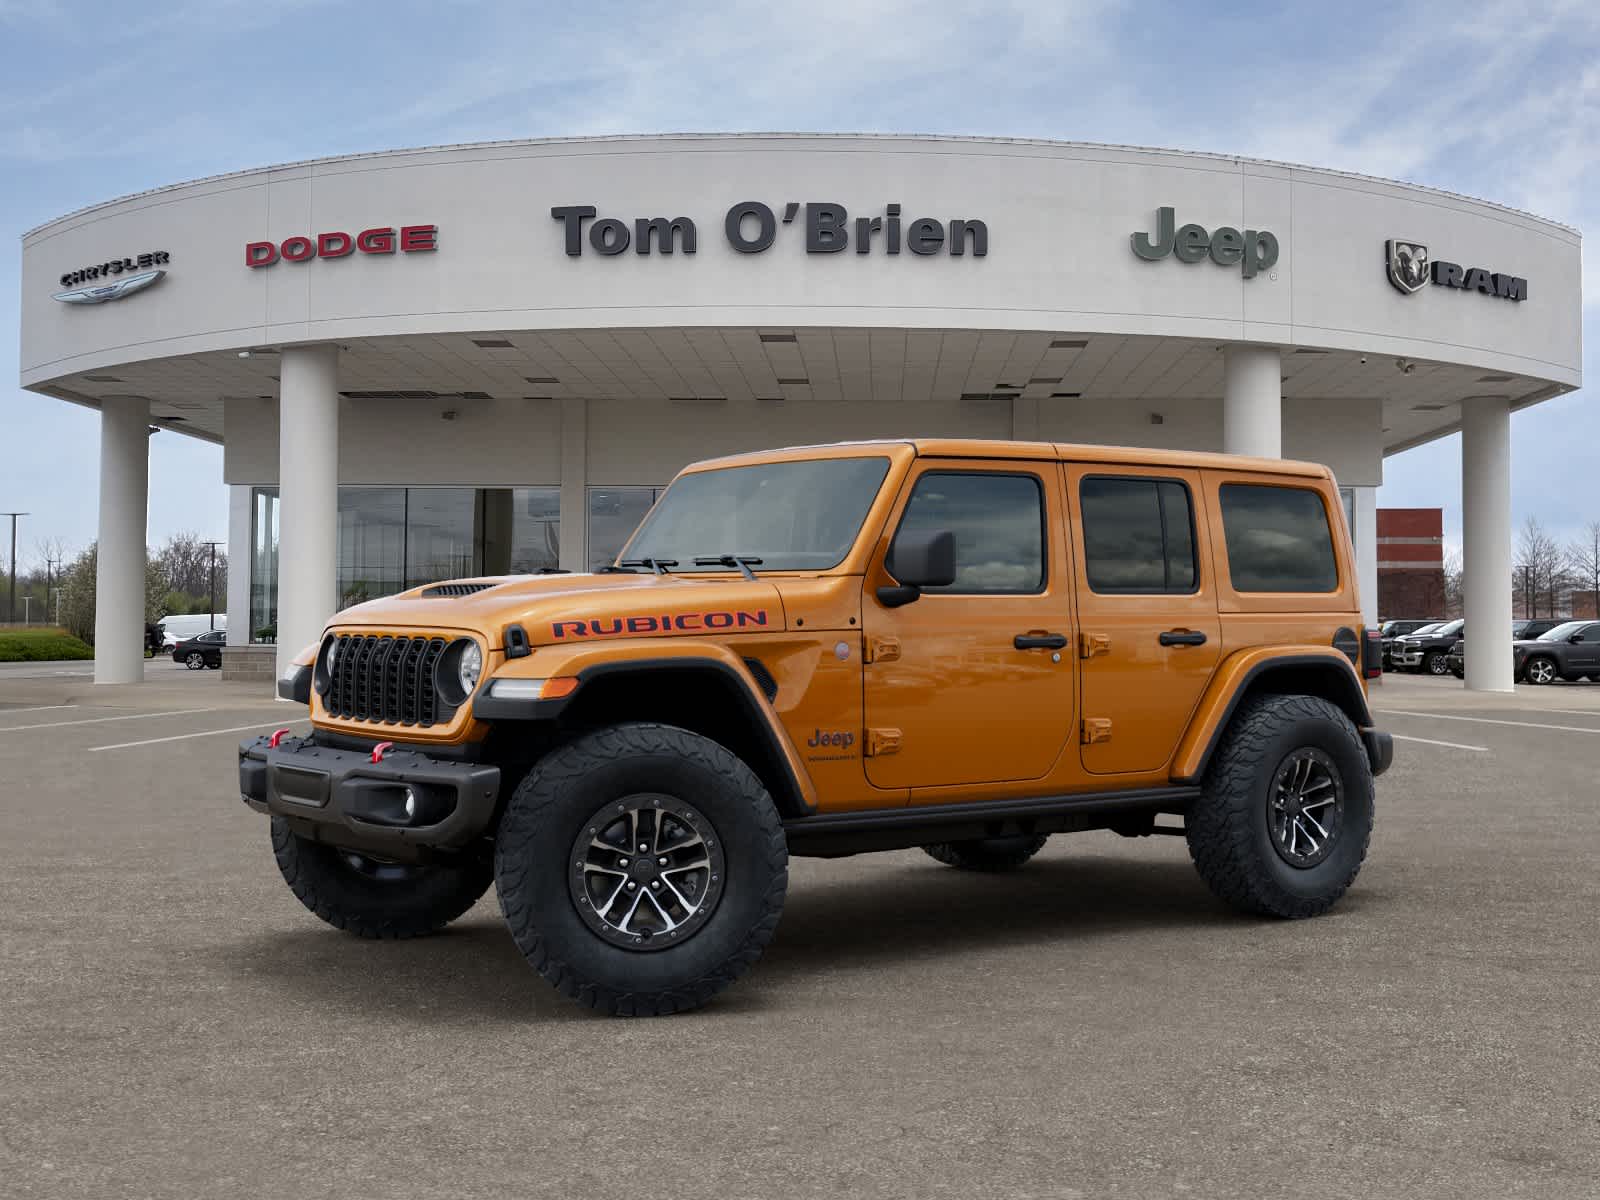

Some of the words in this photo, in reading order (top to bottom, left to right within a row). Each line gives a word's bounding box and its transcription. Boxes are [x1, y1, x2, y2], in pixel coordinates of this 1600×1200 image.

[245, 225, 438, 269] DODGE
[551, 205, 697, 256] Tom
[725, 201, 988, 256] O'Brien
[1130, 206, 1279, 279] Jeep
[60, 249, 170, 287] CHRYSLER
[1430, 260, 1528, 302] RAM
[552, 609, 768, 639] RUBICON
[807, 727, 854, 749] Jeep
